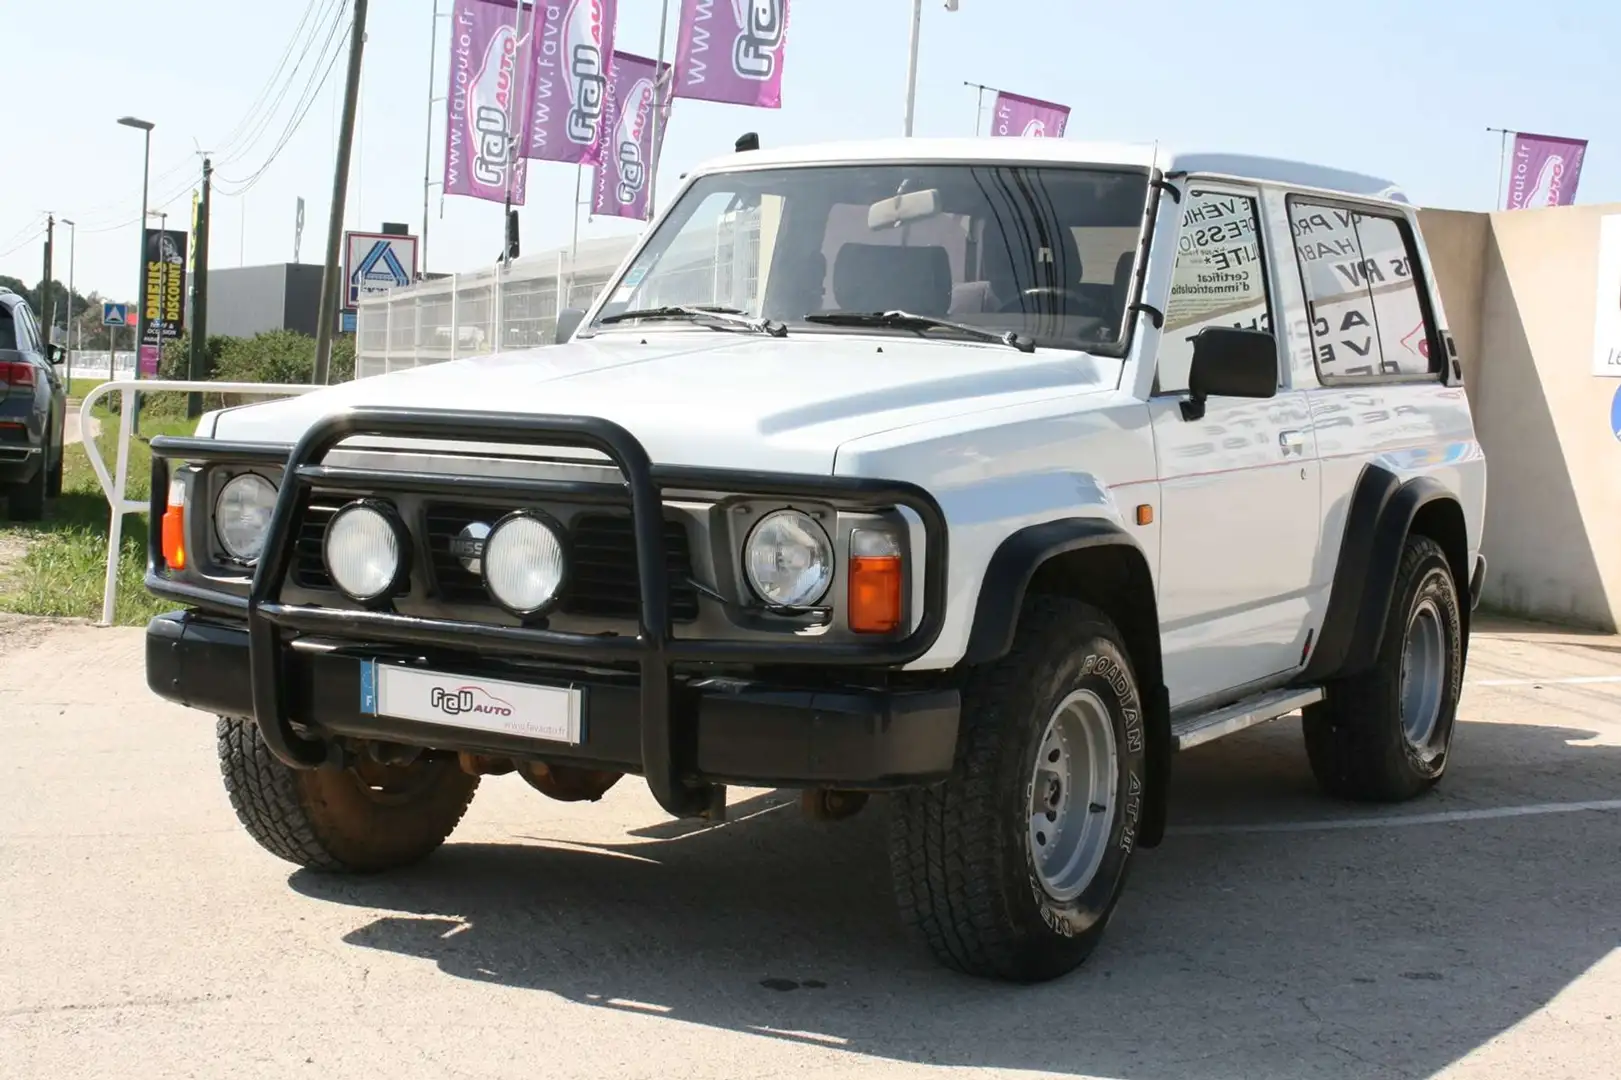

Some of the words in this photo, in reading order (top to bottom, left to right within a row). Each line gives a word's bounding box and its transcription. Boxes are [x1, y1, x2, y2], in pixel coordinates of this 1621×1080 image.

[447, 7, 478, 186] www.favauto.fr
[496, 37, 516, 109] AUTO
[147, 261, 167, 320] PNEUS
[166, 262, 181, 321] DISCOUNT
[366, 695, 373, 706] F
[474, 704, 512, 717] AUTO
[1081, 654, 1143, 753] ROADIAN
